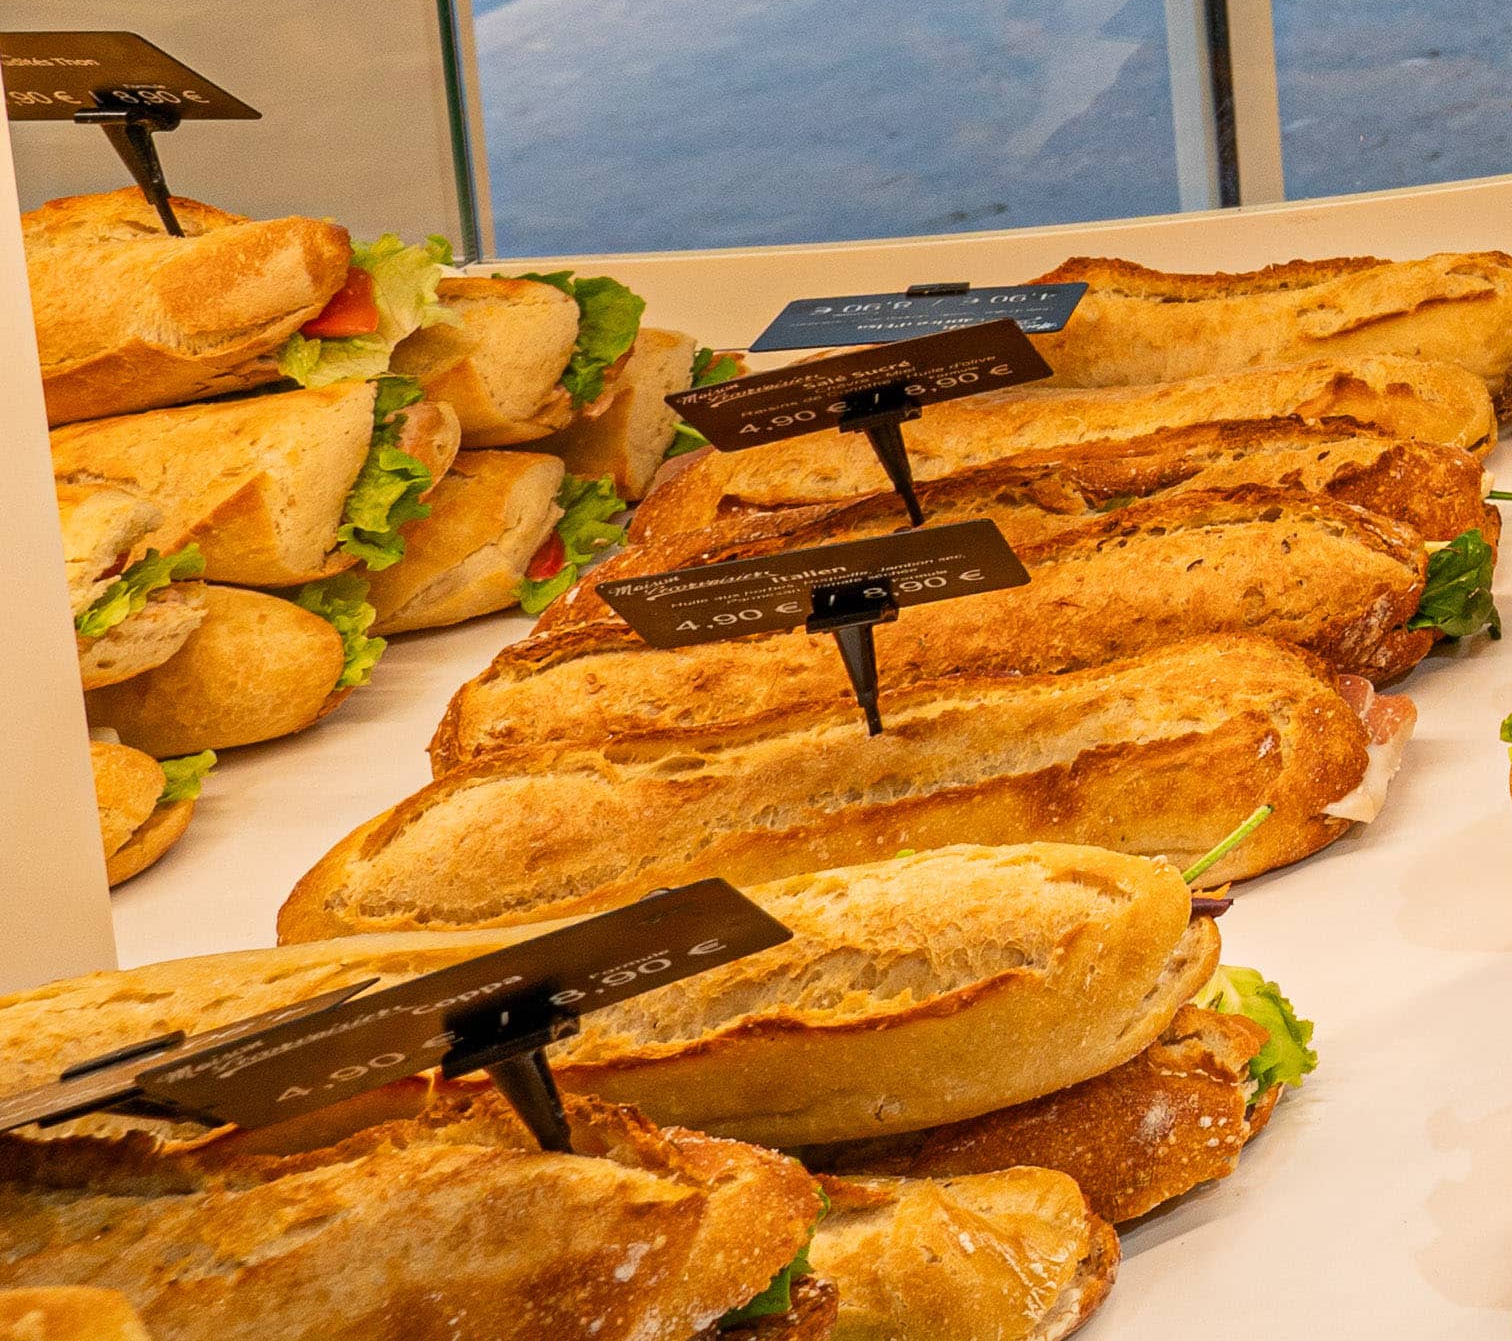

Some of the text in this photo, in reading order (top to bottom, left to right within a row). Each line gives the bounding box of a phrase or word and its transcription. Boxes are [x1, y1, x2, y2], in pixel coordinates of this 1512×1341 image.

[2, 57, 53, 67] udités
[8, 91, 53, 107] ,90
[852, 360, 912, 379] Sucré
[739, 410, 817, 436] 4,90
[904, 372, 980, 397] 8,90
[988, 363, 1014, 377] €
[771, 565, 848, 584] Italien
[608, 575, 681, 598] Maison
[676, 609, 763, 632] 4,90
[775, 601, 803, 614] €
[863, 576, 948, 599] 8,90
[959, 569, 986, 582] €
[412, 974, 523, 1016] Coppa
[277, 1052, 406, 1103] 4,90
[549, 958, 672, 1006] 8,90
[687, 938, 727, 957] €
